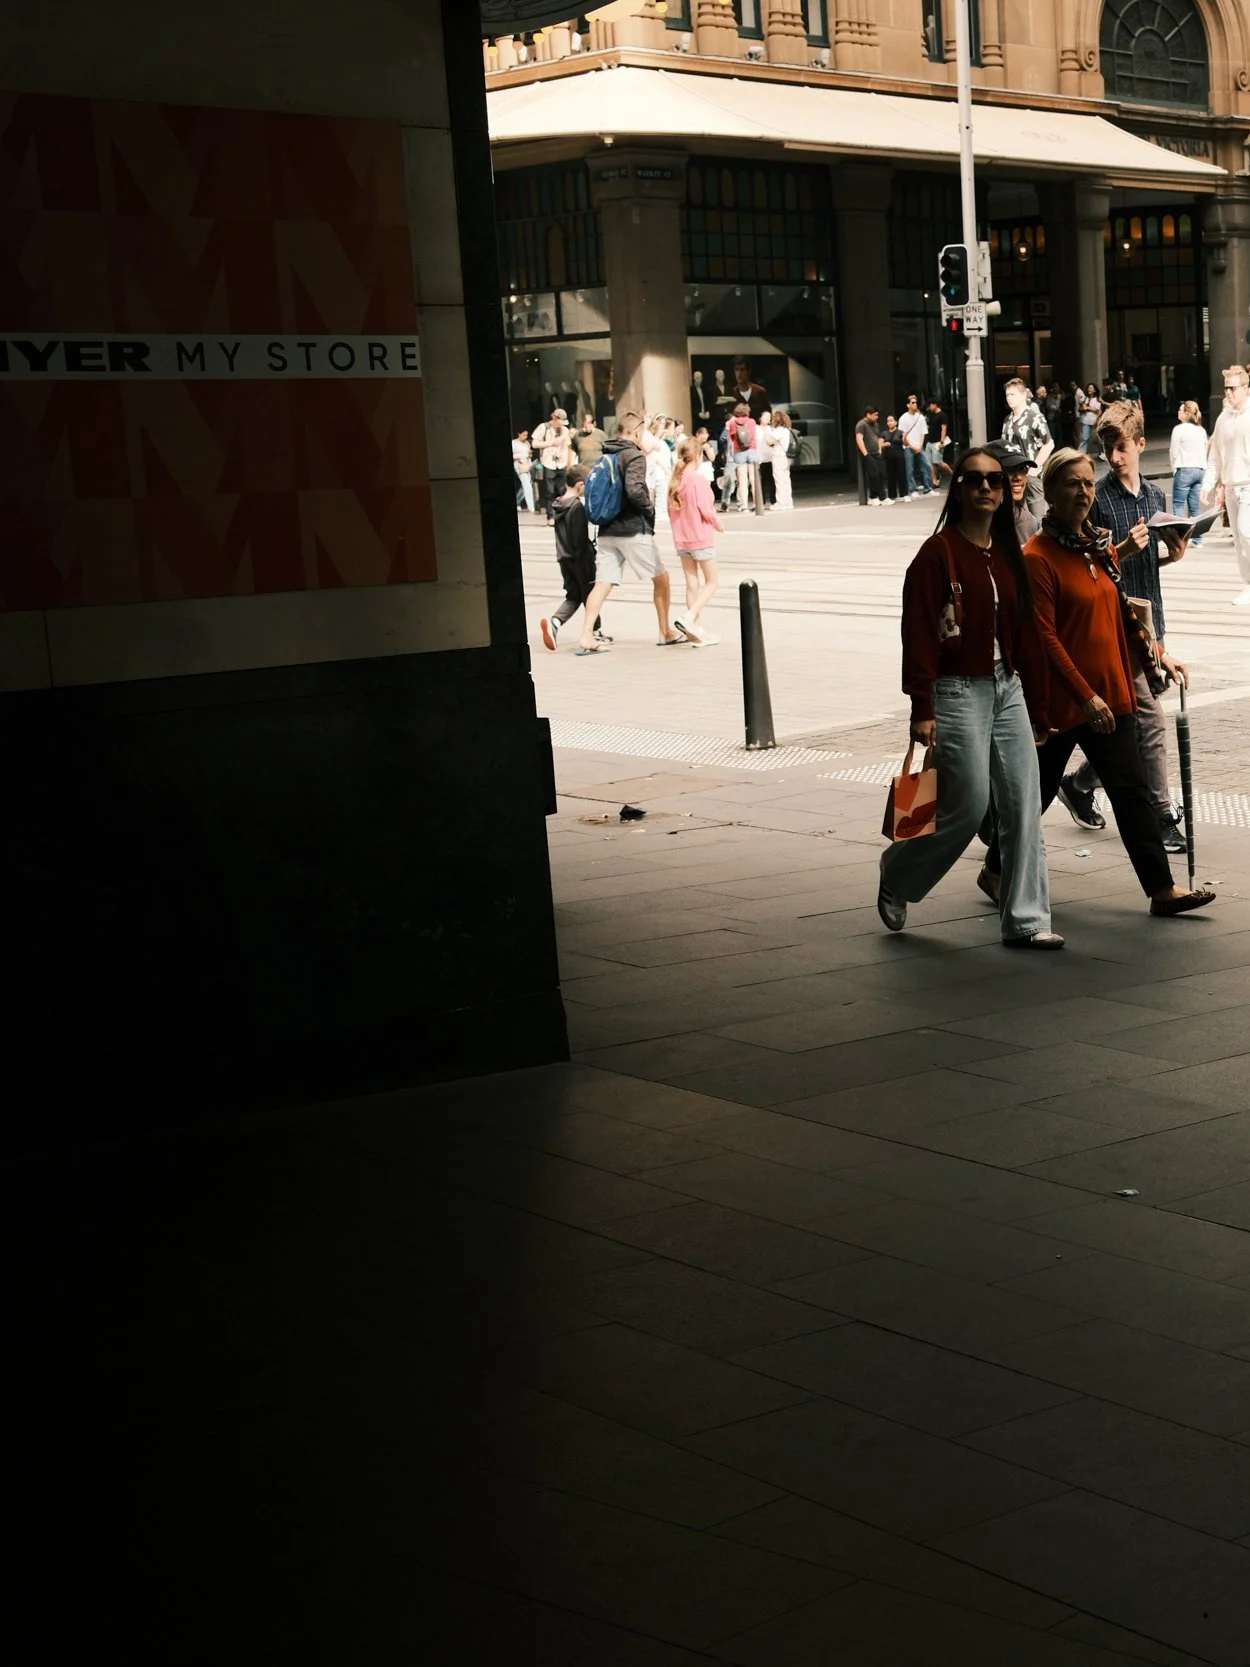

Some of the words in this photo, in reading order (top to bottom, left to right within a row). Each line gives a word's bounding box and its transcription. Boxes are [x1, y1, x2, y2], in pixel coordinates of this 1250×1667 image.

[0, 340, 152, 373] YER
[176, 341, 241, 372] MY
[267, 341, 419, 372] STORE
